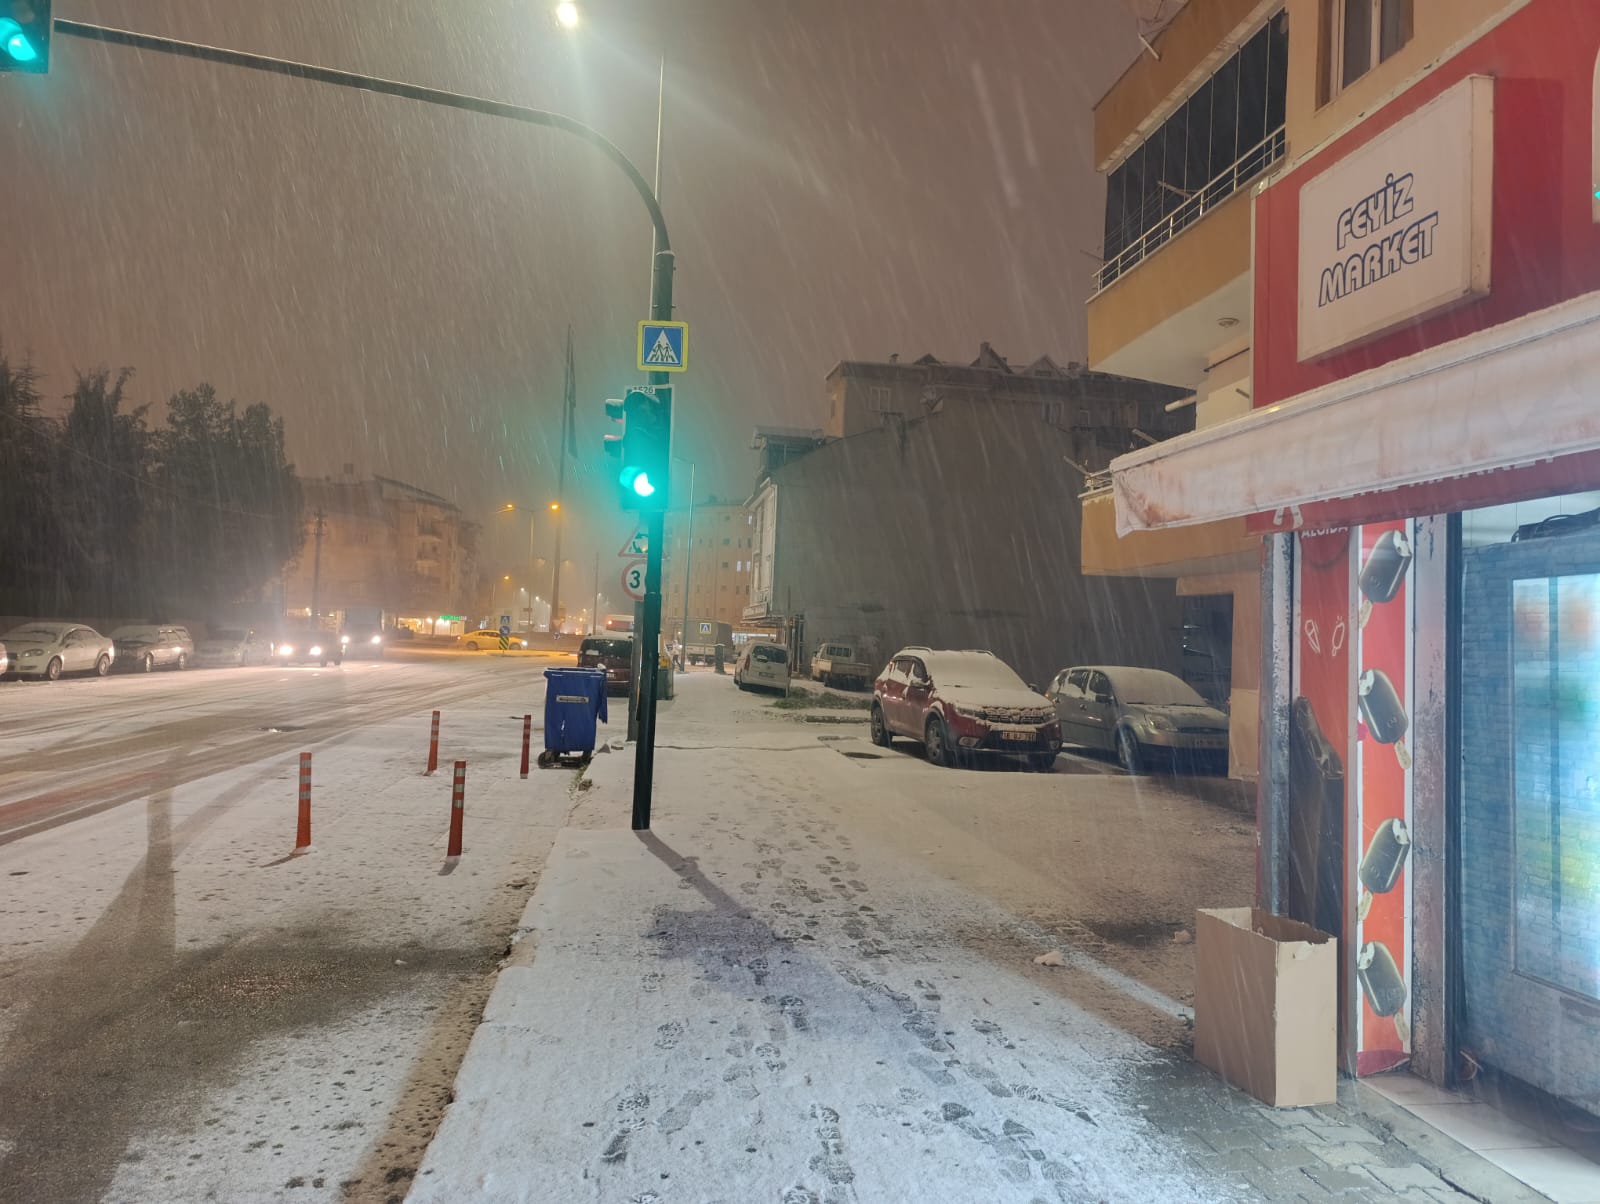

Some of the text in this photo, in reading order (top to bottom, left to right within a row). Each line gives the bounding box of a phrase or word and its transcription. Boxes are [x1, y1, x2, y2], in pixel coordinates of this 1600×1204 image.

[1337, 173, 1414, 251] FEYİZ
[1318, 211, 1439, 307] MARKET
[628, 570, 641, 589] 3
